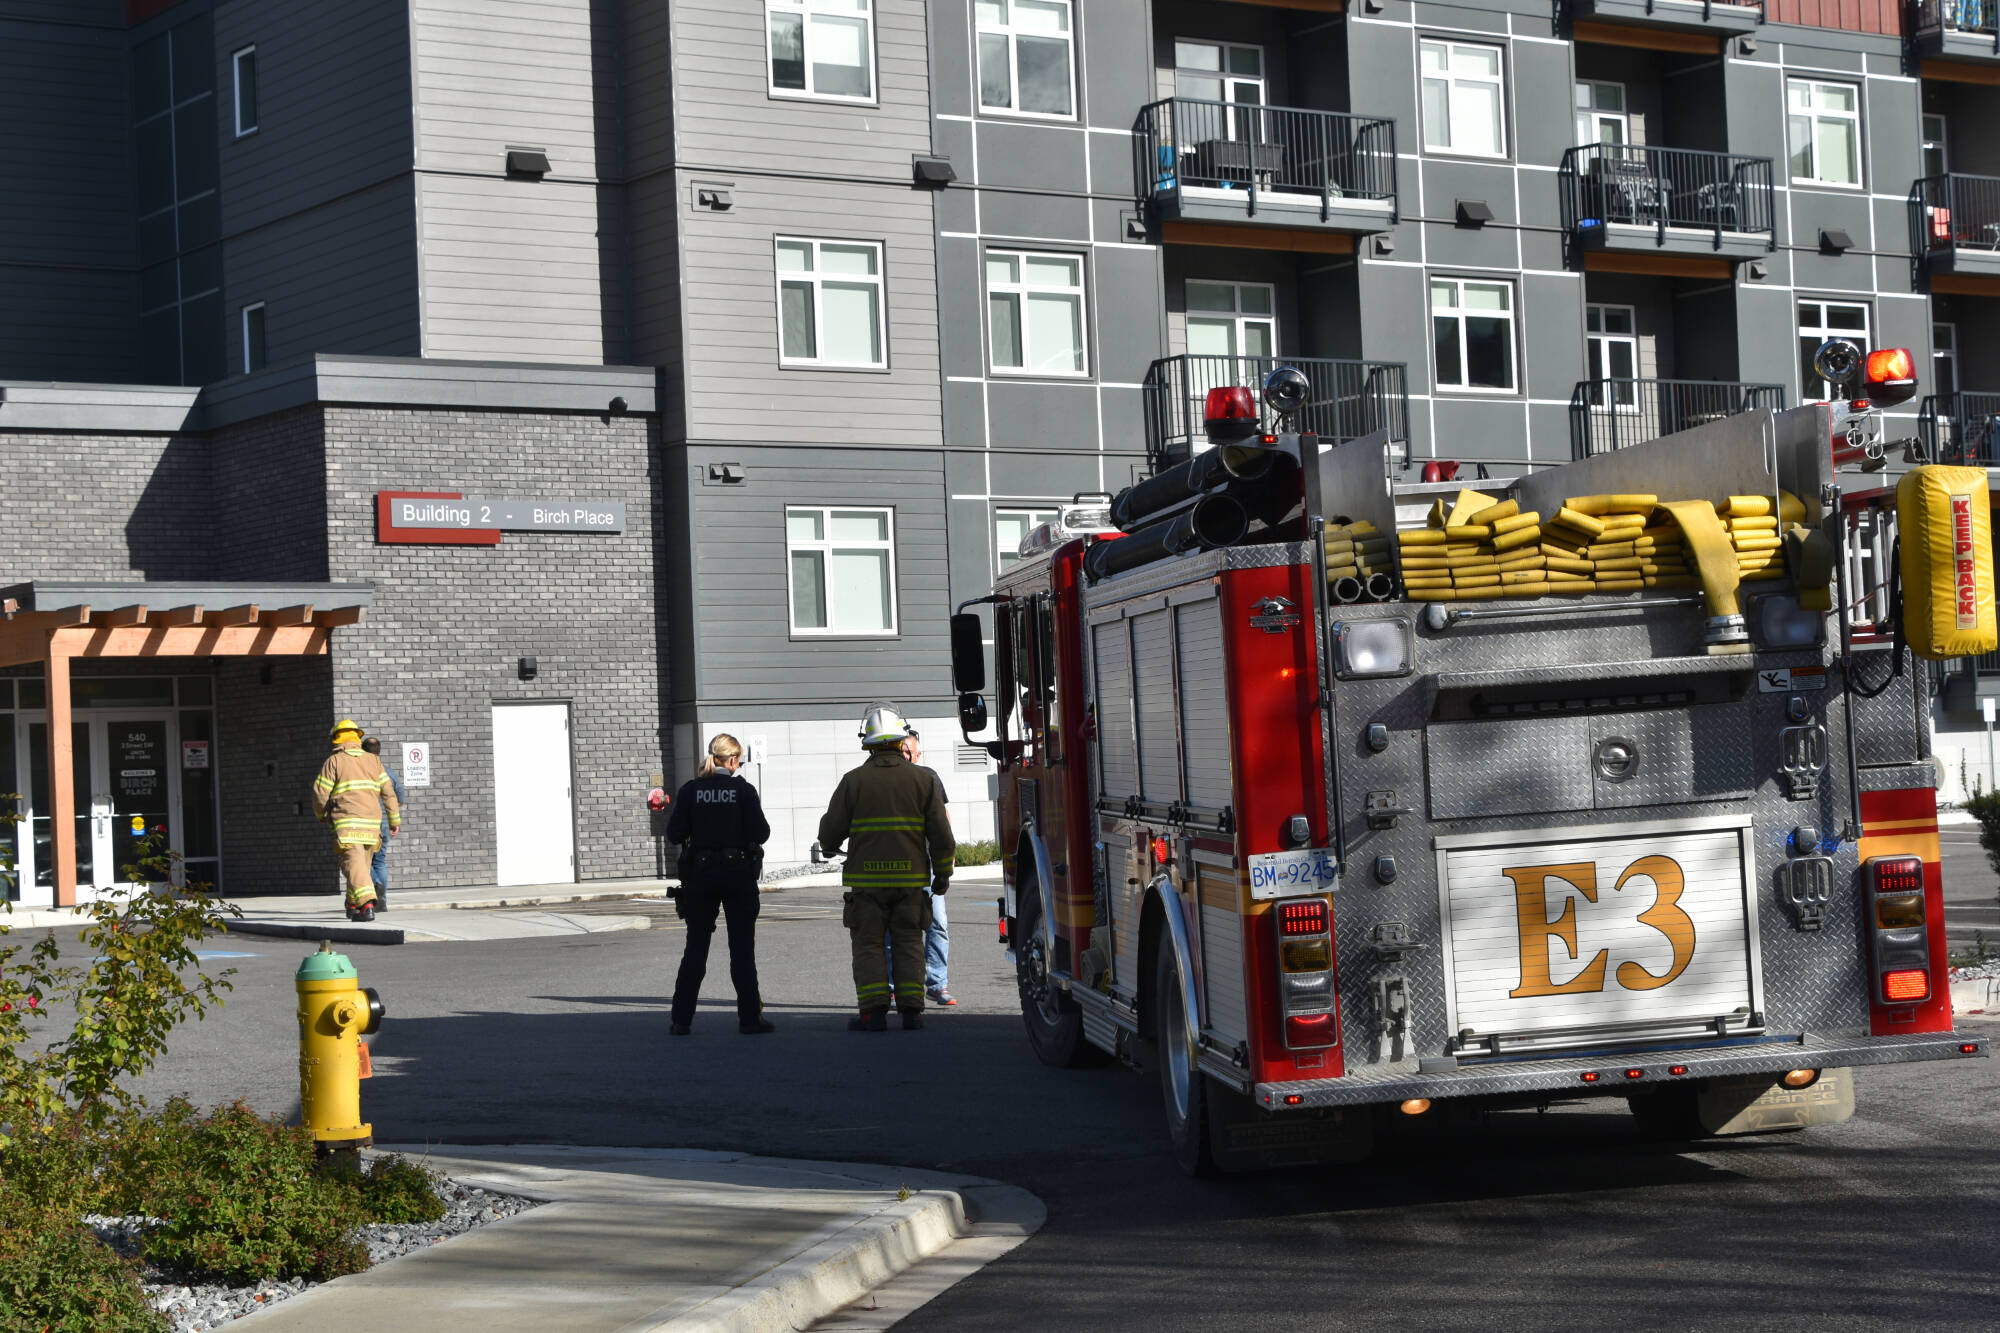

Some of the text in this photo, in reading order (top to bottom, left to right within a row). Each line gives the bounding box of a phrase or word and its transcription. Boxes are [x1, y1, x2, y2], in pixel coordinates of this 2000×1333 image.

[403, 504, 470, 526] Building
[480, 506, 491, 523] 2
[533, 509, 570, 524] Birch
[574, 510, 614, 525] Place
[1953, 500, 1972, 555] KEEP
[1956, 559, 1975, 615] BACK
[128, 733, 146, 742] 540
[696, 789, 737, 803] POLICE
[863, 861, 910, 870] SHIRLEY
[1252, 859, 1336, 888] BM 9245
[1502, 854, 1697, 999] E3
